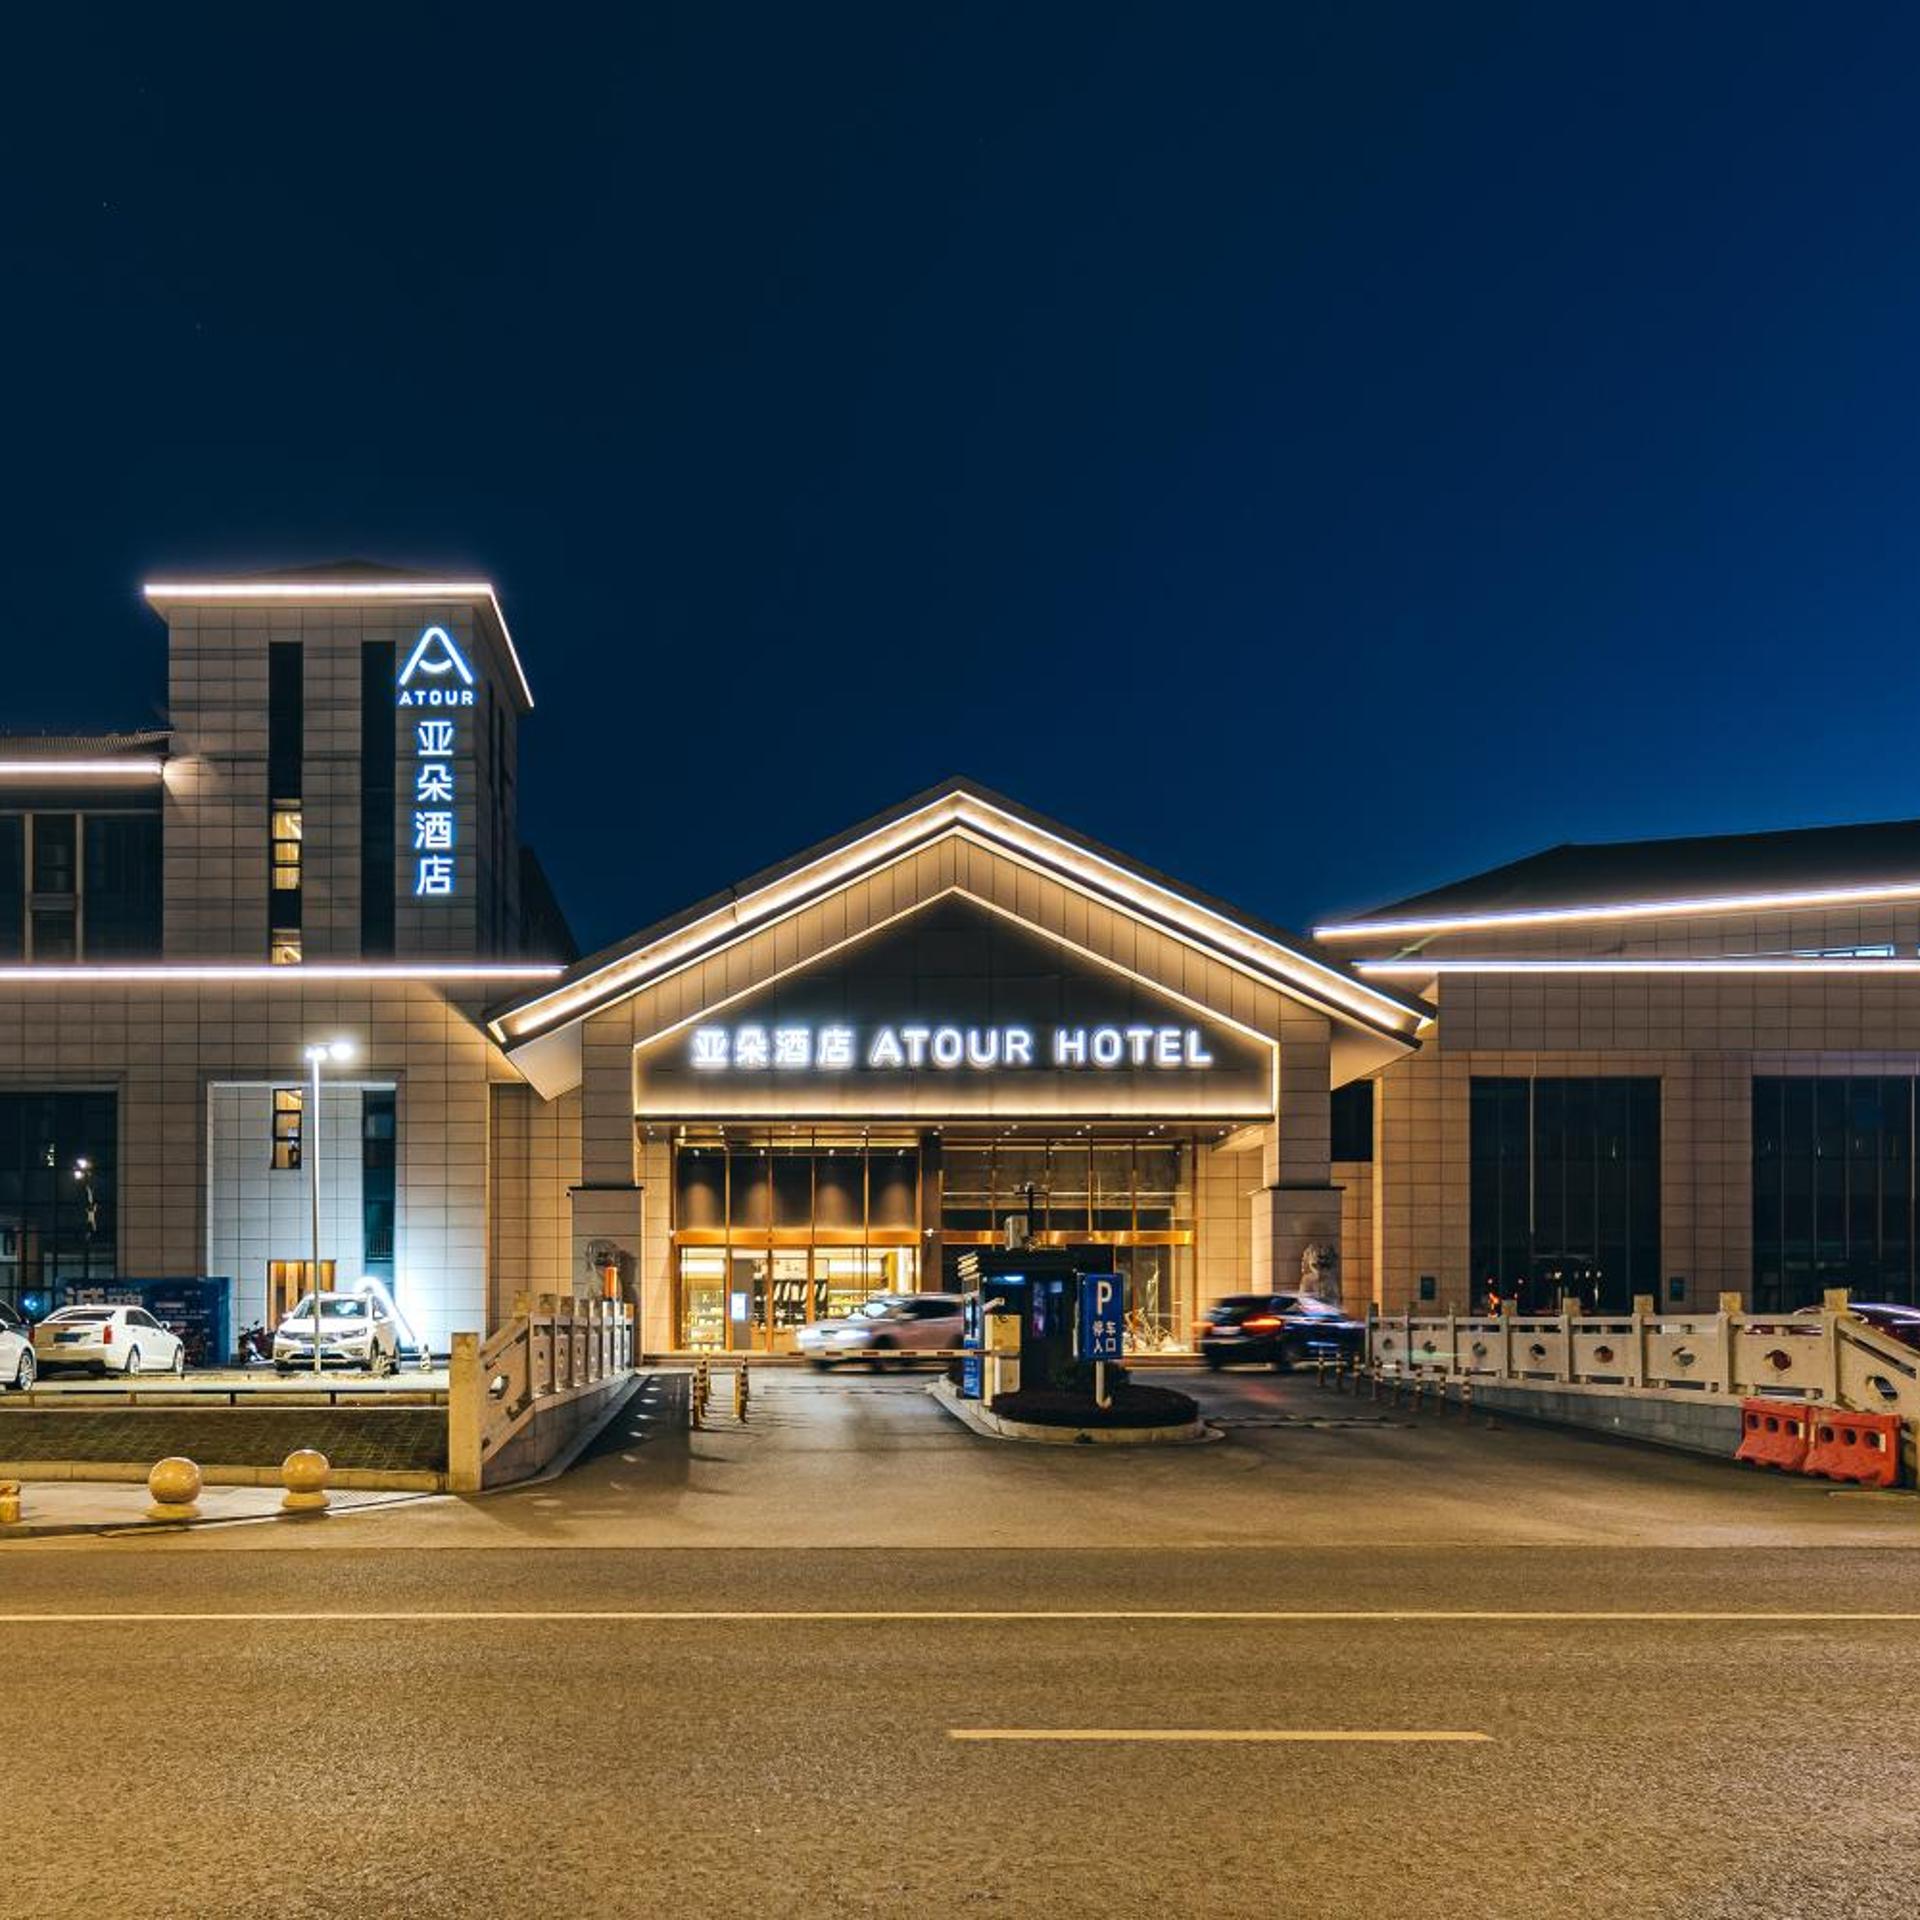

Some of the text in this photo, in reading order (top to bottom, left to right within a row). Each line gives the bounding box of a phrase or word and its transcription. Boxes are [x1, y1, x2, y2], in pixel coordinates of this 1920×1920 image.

[399, 690, 474, 706] ATOUR
[415, 720, 454, 896] 亚朵酒店
[692, 1027, 1213, 1069] 亚朵酒店 ATOUR HOTEL
[1097, 1280, 1113, 1315] P
[1092, 1320, 1116, 1337] 停车
[1093, 1337, 1117, 1354] 入口
